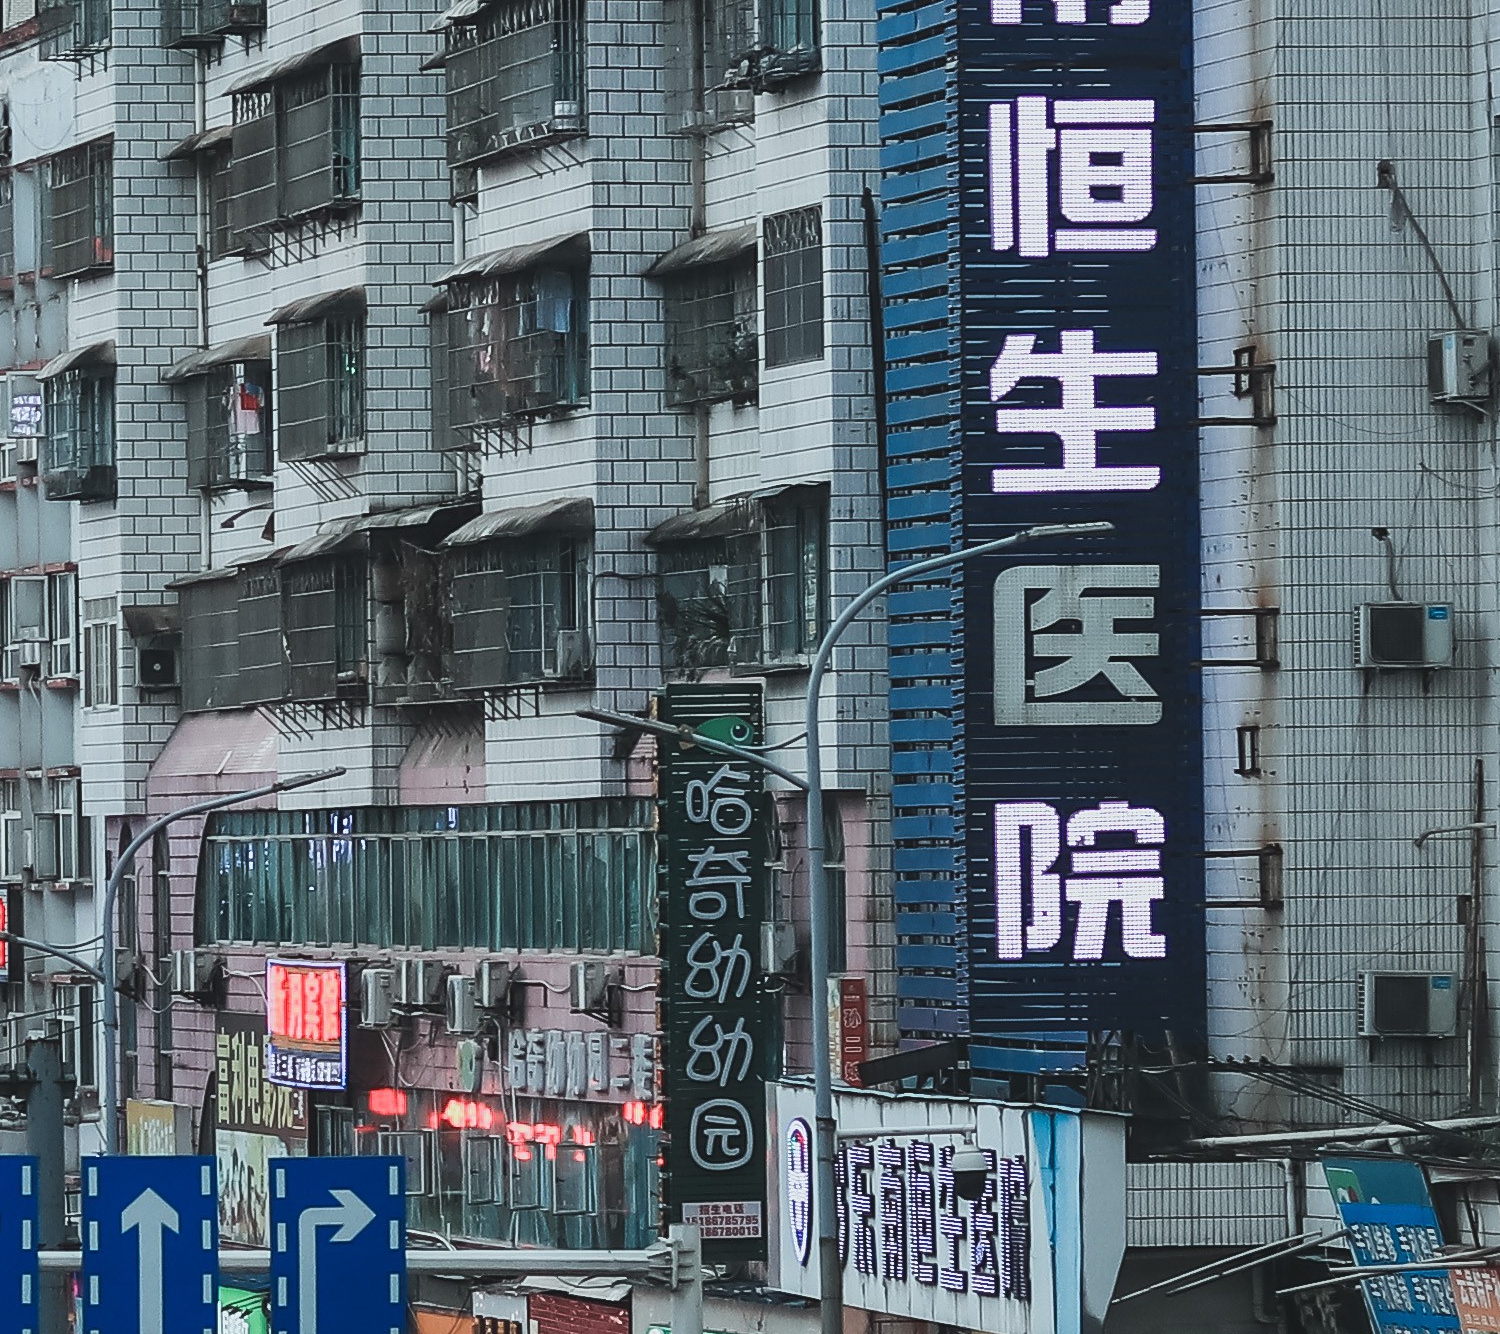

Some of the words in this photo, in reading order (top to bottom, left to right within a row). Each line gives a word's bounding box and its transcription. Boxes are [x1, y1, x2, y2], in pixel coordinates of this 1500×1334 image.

[834, 1138, 1031, 1302] 东南恒生医院
